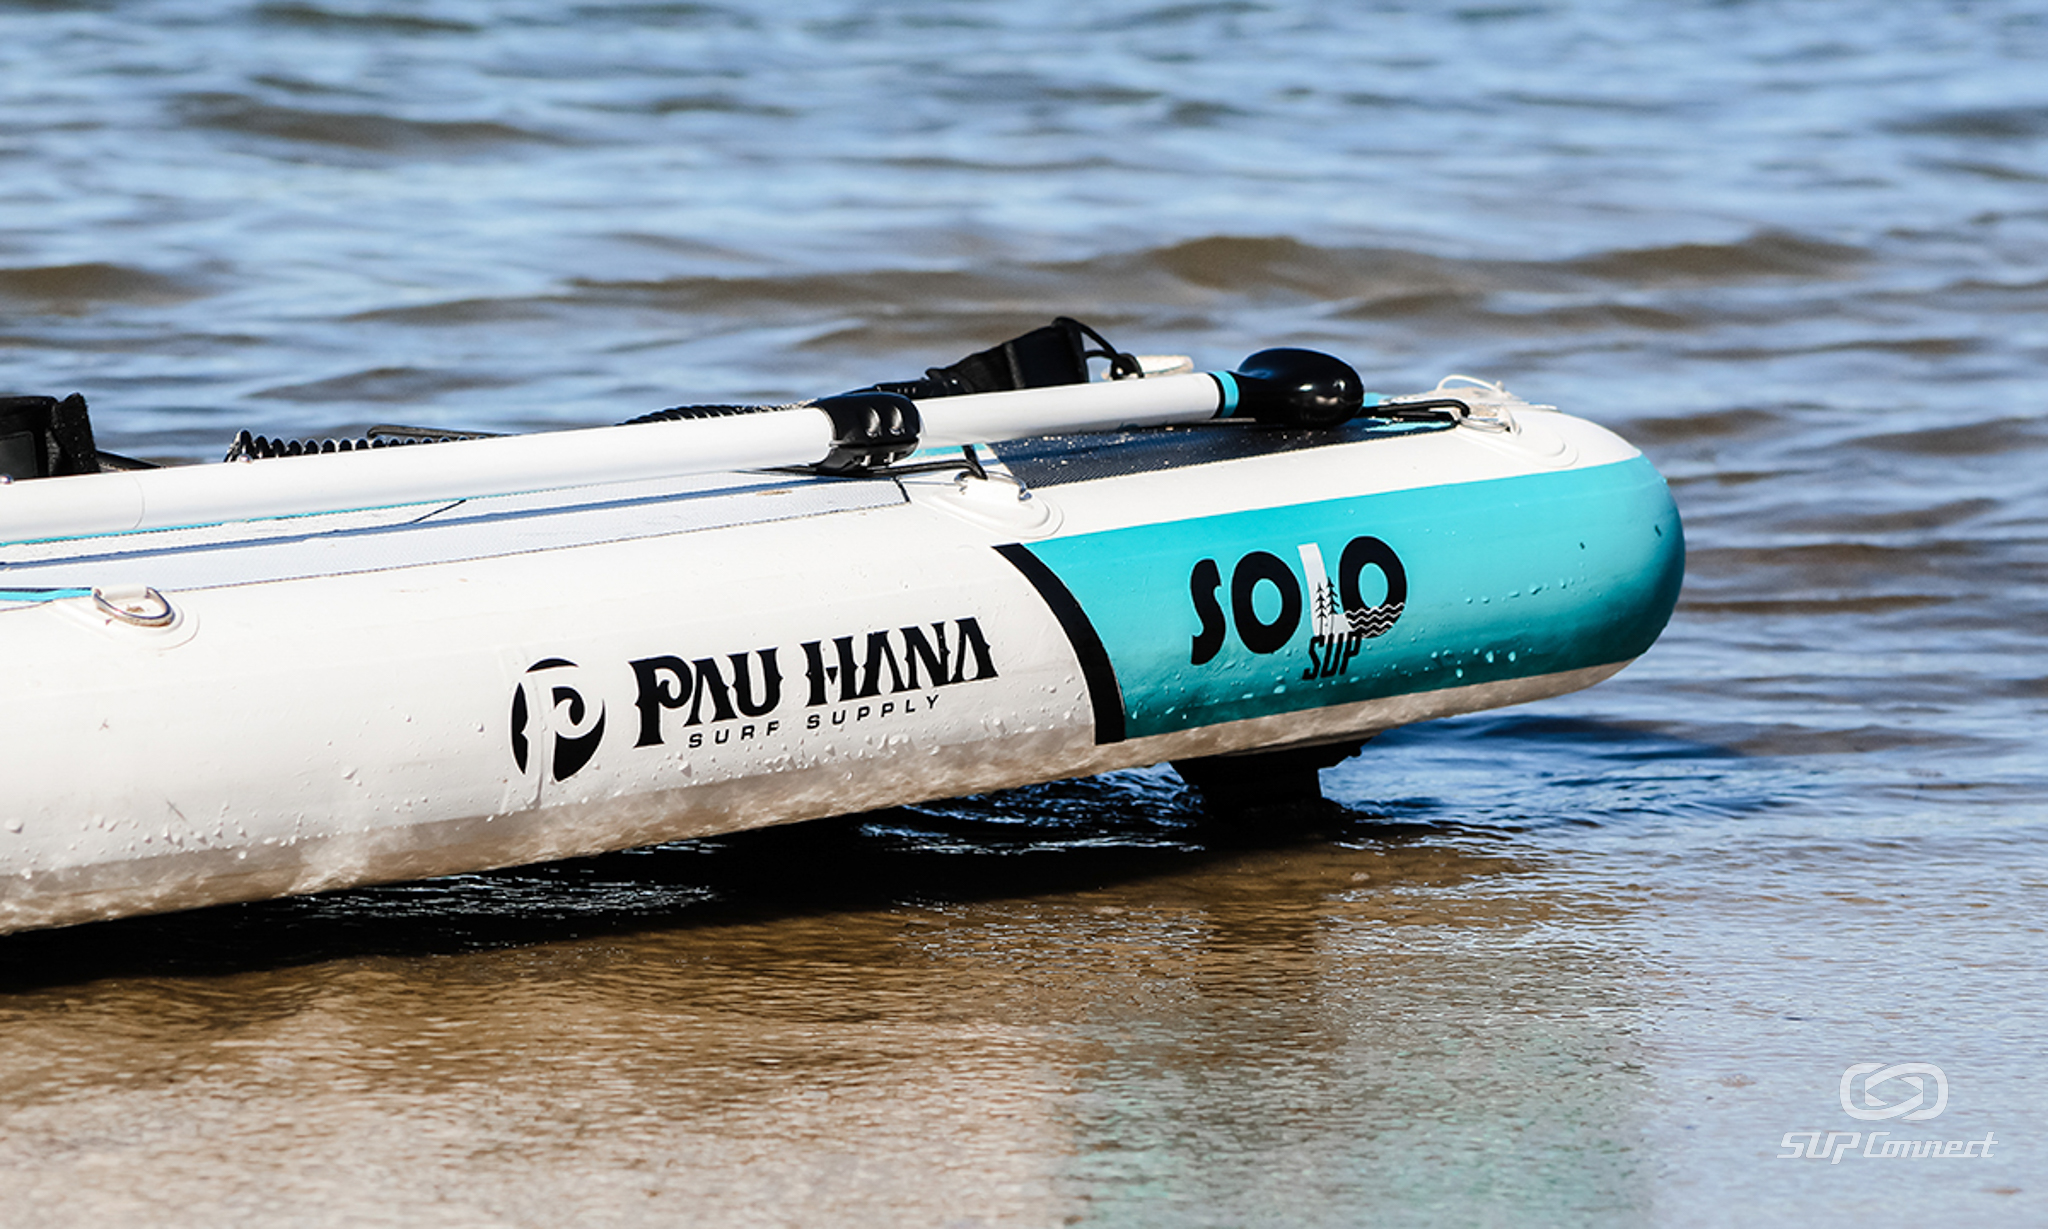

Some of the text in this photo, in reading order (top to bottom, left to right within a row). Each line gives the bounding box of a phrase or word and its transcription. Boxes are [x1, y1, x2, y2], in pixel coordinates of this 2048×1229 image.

[1189, 535, 1408, 666] SOLO
[627, 616, 999, 749] PAU HANA
[1301, 630, 1363, 681] SUP
[687, 694, 941, 749] SURF SUPPLY
